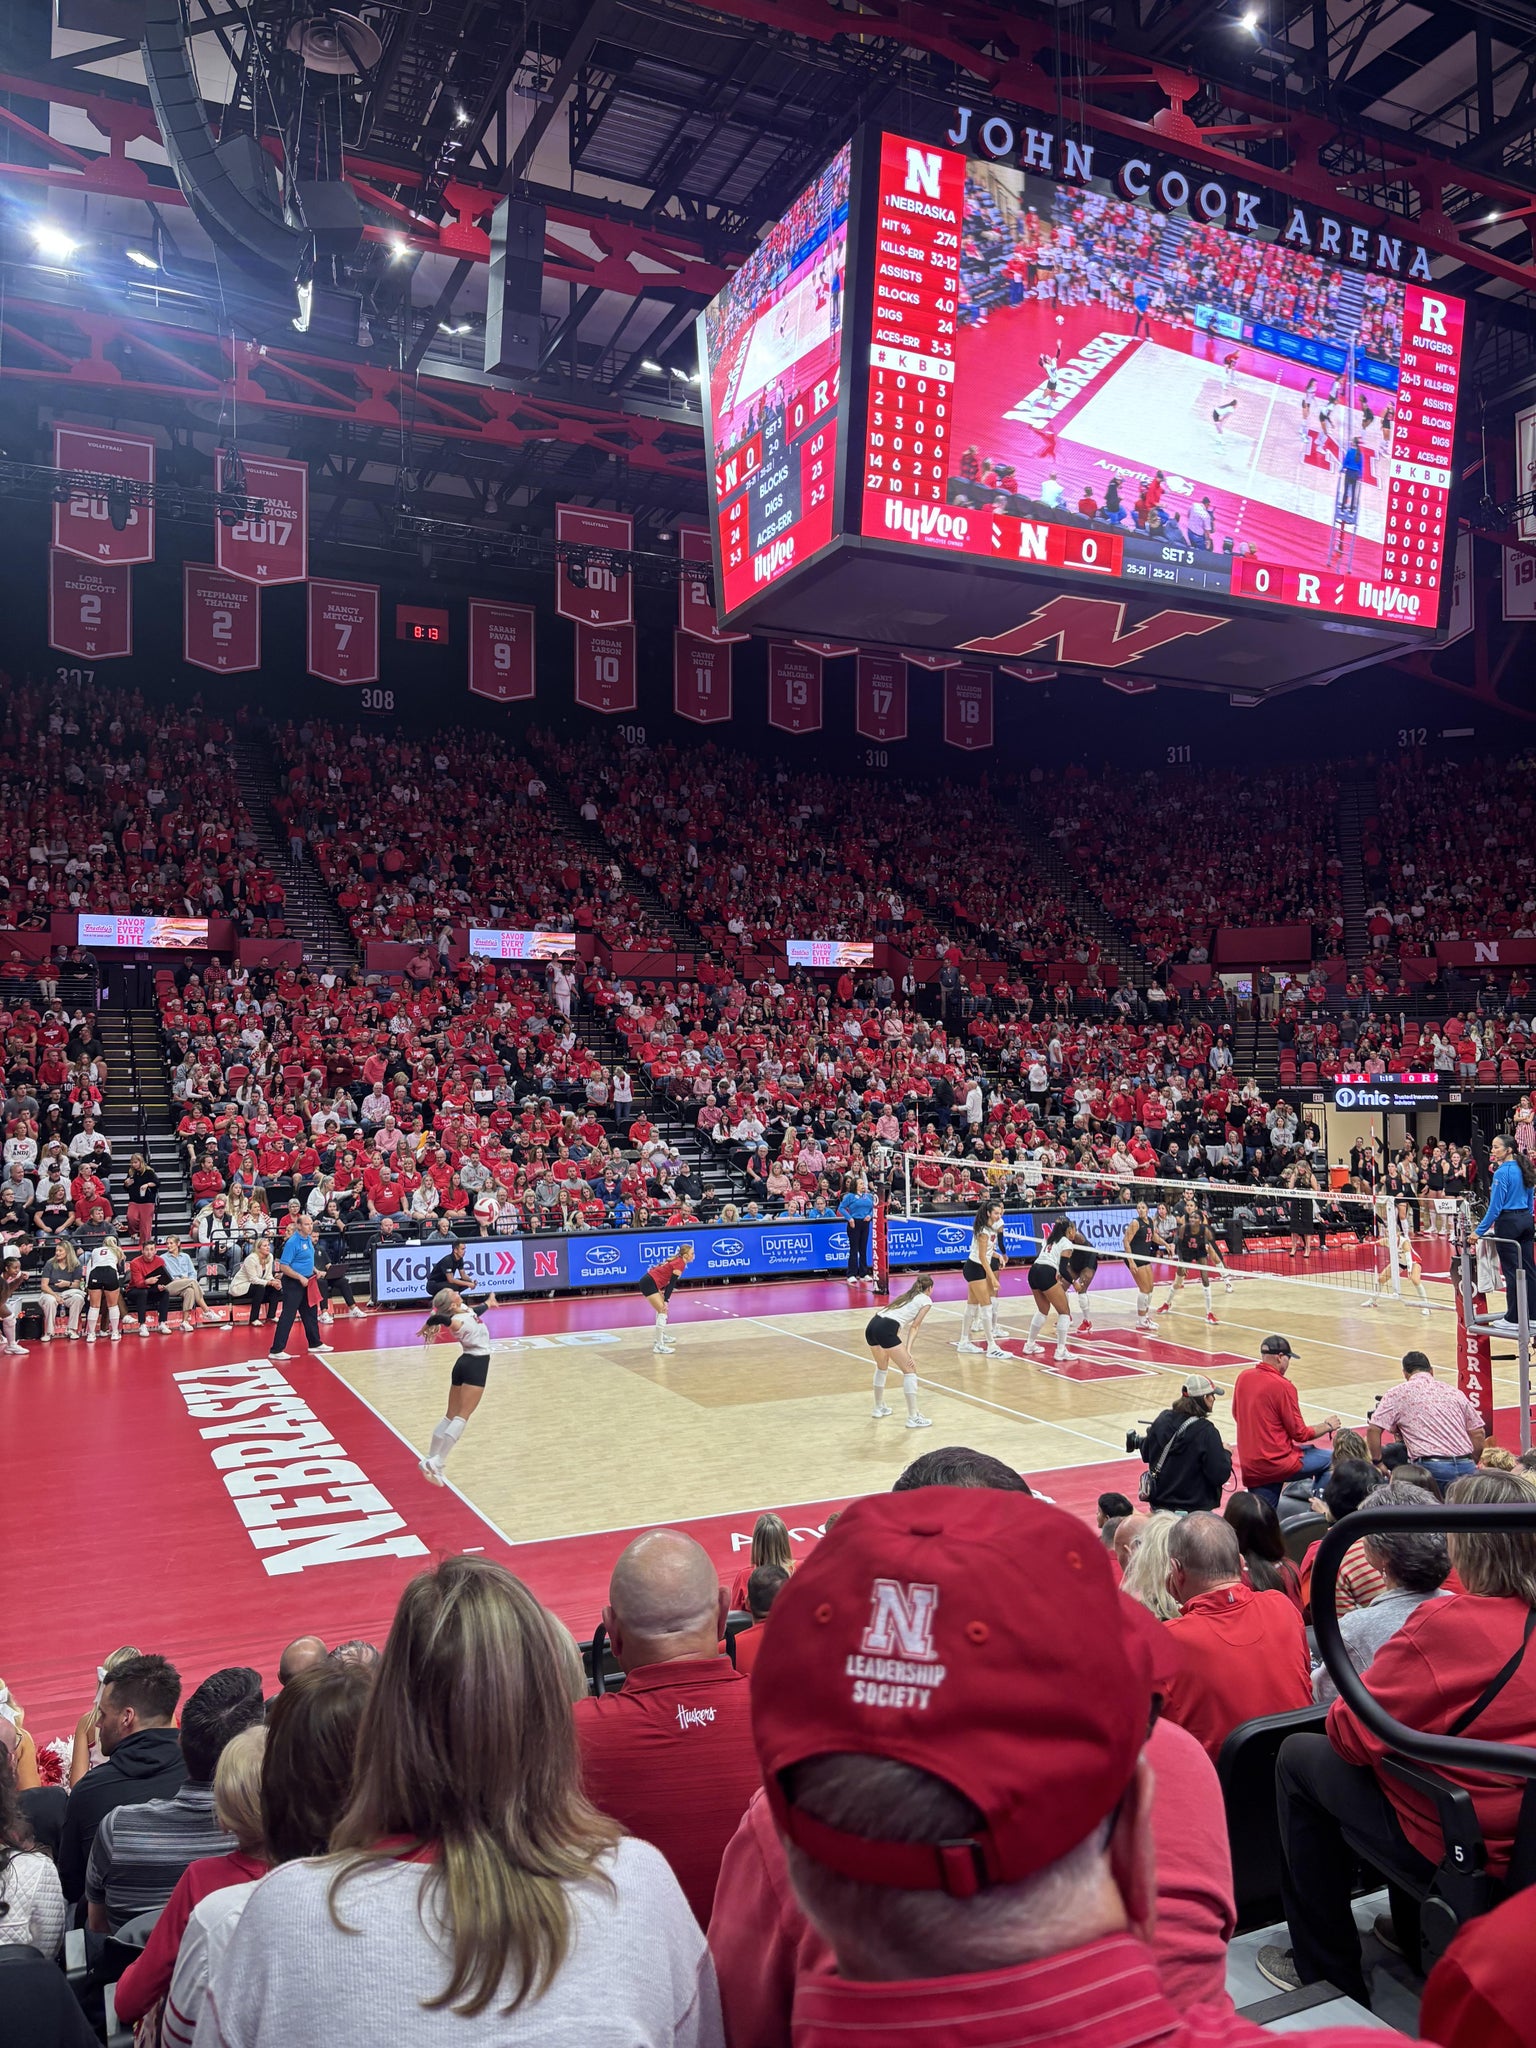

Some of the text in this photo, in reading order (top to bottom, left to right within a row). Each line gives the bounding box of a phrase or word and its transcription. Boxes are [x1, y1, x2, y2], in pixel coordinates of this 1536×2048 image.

[905, 147, 942, 199] N
[947, 107, 1432, 281] JOHN COOK ARENA
[884, 194, 956, 224] 1 NEBRASKA
[882, 218, 957, 248] HIT % .274
[881, 240, 957, 270] KILLS-ERR 32-12
[880, 264, 956, 292] ASSISTS 31
[878, 285, 954, 313] BLOCKS 4.0
[878, 306, 953, 334] DIGS 24
[1420, 296, 1447, 336] R
[876, 329, 952, 356] ACES-ERR 3-3
[1413, 335, 1454, 356] RUTGERS
[899, 355, 948, 376] K B D
[1402, 353, 1416, 366] .191
[1436, 362, 1448, 373] HIT
[878, 371, 946, 398] 1 0 0 3
[1401, 372, 1455, 394] 26-13 KILLS-ERR
[814, 380, 830, 415] R
[875, 392, 945, 418] 2 1 1 0
[1400, 390, 1453, 412] 26 ASSISTS
[794, 404, 804, 427] 0
[874, 412, 944, 438] 3 3 0 0
[1398, 408, 1452, 430] 6.0 BLOCKS
[765, 419, 778, 440] SET
[1396, 426, 1450, 448] 23 DIGS
[870, 432, 942, 458] 10 0 0 6
[1394, 445, 1448, 466] 2-2 ACES-ERR
[746, 448, 754, 469] 0
[870, 453, 942, 479] 14 6 2 0
[725, 458, 738, 492] N
[730, 503, 741, 522] 4.0
[760, 465, 788, 498] BLOCKS
[811, 435, 824, 456] 6.0
[867, 474, 940, 499] 27 10 1 3
[1410, 467, 1446, 484] K B D
[730, 460, 822, 545] 24 DIGS 23
[730, 484, 825, 567] 3-3 ACES-ERR 2-2
[884, 498, 968, 540] HyVee
[232, 519, 292, 546] 2017
[1018, 522, 1049, 561] N
[754, 536, 794, 582] HyVee
[1081, 538, 1098, 563] 0
[1162, 547, 1194, 564] SET 3
[78, 574, 102, 584] LORI
[1126, 564, 1146, 576] 25-21
[1152, 568, 1174, 580] 25-22
[1256, 569, 1270, 592] 0
[65, 581, 117, 594] ENDICOTT
[196, 590, 248, 602] STEPHANIE
[1296, 573, 1320, 604] R
[1358, 582, 1420, 616] HyVee
[80, 594, 101, 624] 2
[204, 599, 240, 610] THATER
[328, 604, 360, 614] NANCY
[212, 610, 232, 640] 2
[414, 626, 439, 640] 8:13
[488, 625, 516, 634] SARAH
[954, 595, 1233, 667] N
[334, 624, 352, 651] 7
[490, 632, 516, 642] PAVAN
[590, 638, 622, 648] JORDAN
[494, 643, 510, 670] 9
[591, 646, 622, 656] LARSON
[691, 651, 715, 660] CATHY
[594, 656, 619, 682] 10
[696, 668, 712, 694] 11
[785, 680, 807, 705] 13
[361, 688, 394, 710] 308
[872, 690, 892, 714] 17
[960, 700, 980, 724] 18
[1398, 728, 1427, 747] 312
[866, 749, 888, 767] 310
[1167, 745, 1191, 764] 311
[117, 918, 144, 926] SAVOR
[117, 926, 145, 934] EVERY
[118, 935, 143, 944] BITE
[502, 932, 524, 940] SAVOR
[502, 948, 522, 957] BITE
[812, 956, 830, 964] BITE
[1474, 942, 1498, 962] N
[1358, 1090, 1390, 1106] fnic
[644, 1246, 680, 1258] DUTEA
[766, 1238, 808, 1250] DUTEAU
[206, 1265, 218, 1276] N
[386, 1252, 492, 1282] Kidell
[534, 1250, 558, 1277] N
[581, 1266, 626, 1277] SUBARU
[708, 1258, 750, 1268] SUBARU
[386, 1285, 419, 1294] Security
[487, 1278, 515, 1287] Control
[172, 1359, 431, 1576] NEBRASKA
[862, 1578, 938, 1660] N
[846, 1655, 946, 1688] LEADERSHIP
[852, 1680, 931, 1710] SOCIETY
[676, 1704, 717, 1729] Huskers
[1454, 1846, 1464, 1862] 5
